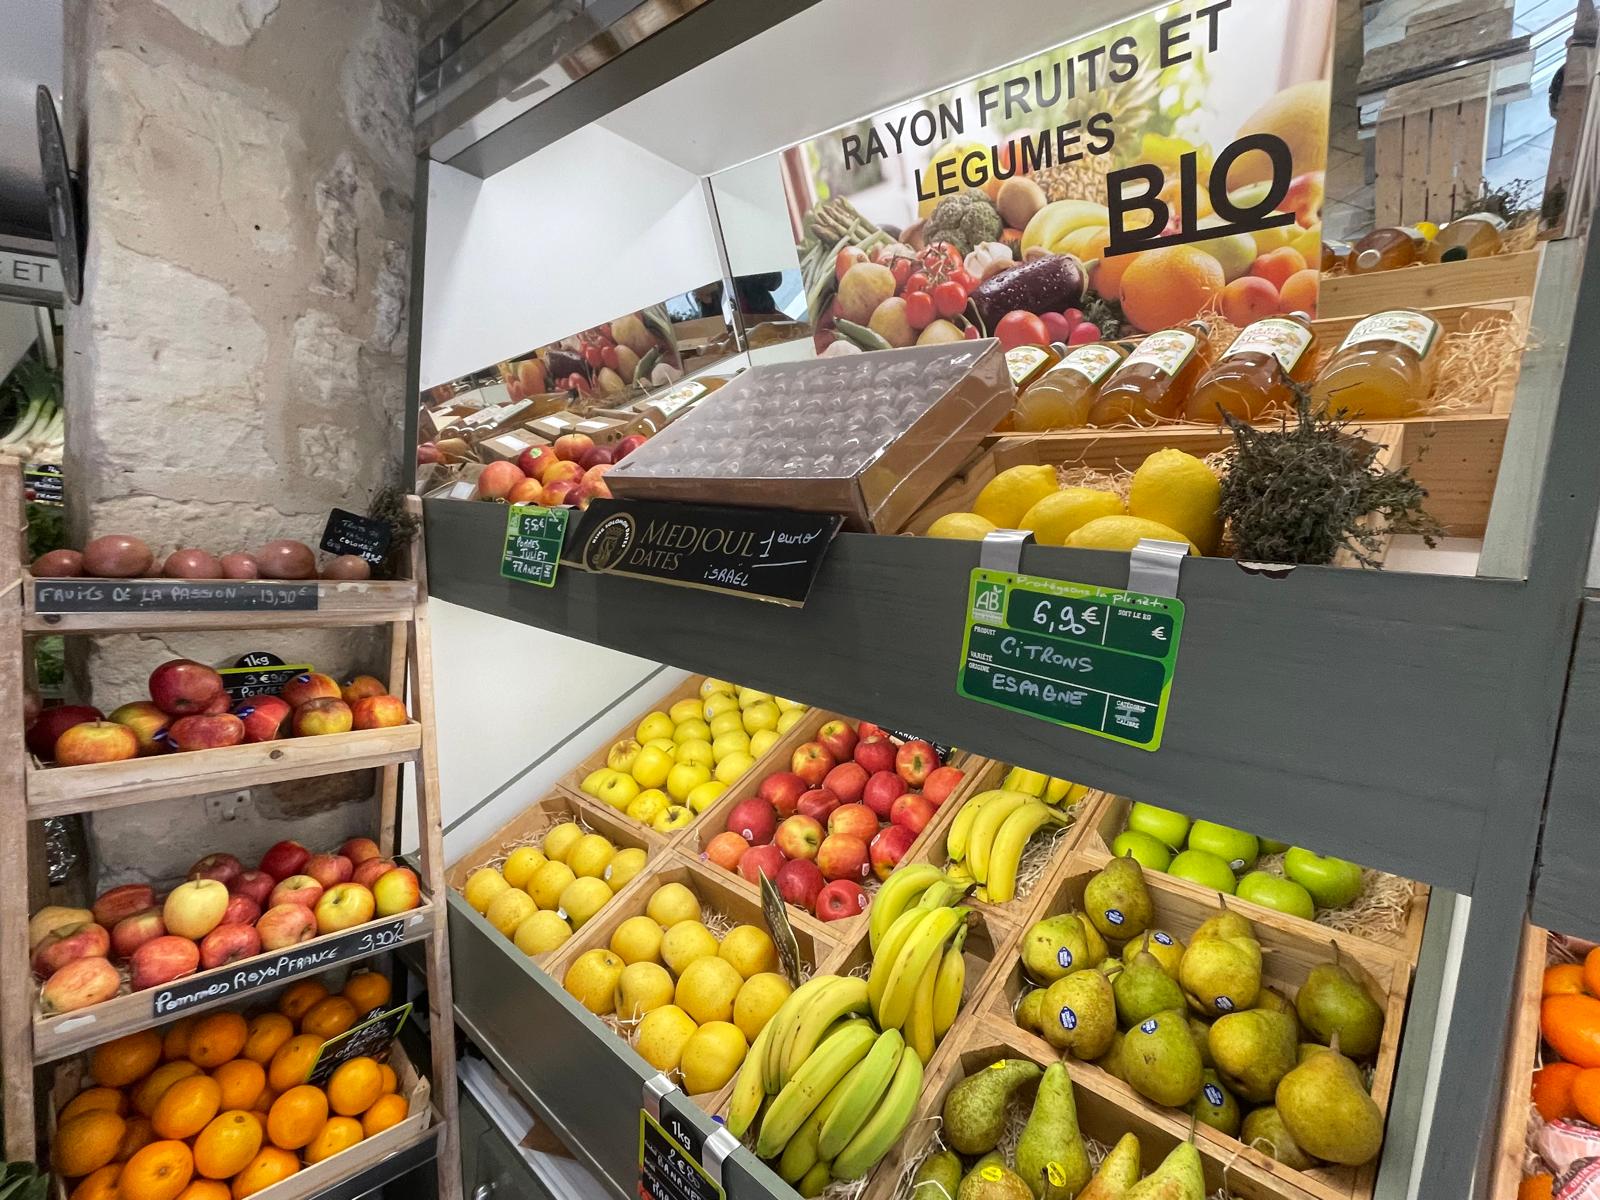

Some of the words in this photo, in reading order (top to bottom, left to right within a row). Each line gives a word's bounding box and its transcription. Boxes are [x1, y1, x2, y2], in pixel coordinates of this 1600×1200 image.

[842, 97, 965, 170] RAYON
[978, 36, 1139, 127] FRUITS
[1160, 0, 1232, 69] ET
[914, 111, 1115, 201] LEGUMES
[1108, 132, 1294, 246] BIO
[13, 260, 51, 282] ET
[640, 519, 757, 559] MEDJOUL
[630, 547, 683, 572] DATES
[140, 586, 162, 602] LA
[975, 588, 1000, 611] AB
[1033, 599, 1101, 635] 6,90€
[1133, 611, 1141, 619] LE
[974, 626, 997, 636] PRODUIT
[1151, 626, 1167, 641] €
[244, 654, 270, 667] 1kg
[968, 662, 990, 673] ORIGINE
[992, 673, 1088, 706] ESPAGNE
[288, 946, 340, 972] FRANCE
[671, 1120, 691, 1151] 1kg
